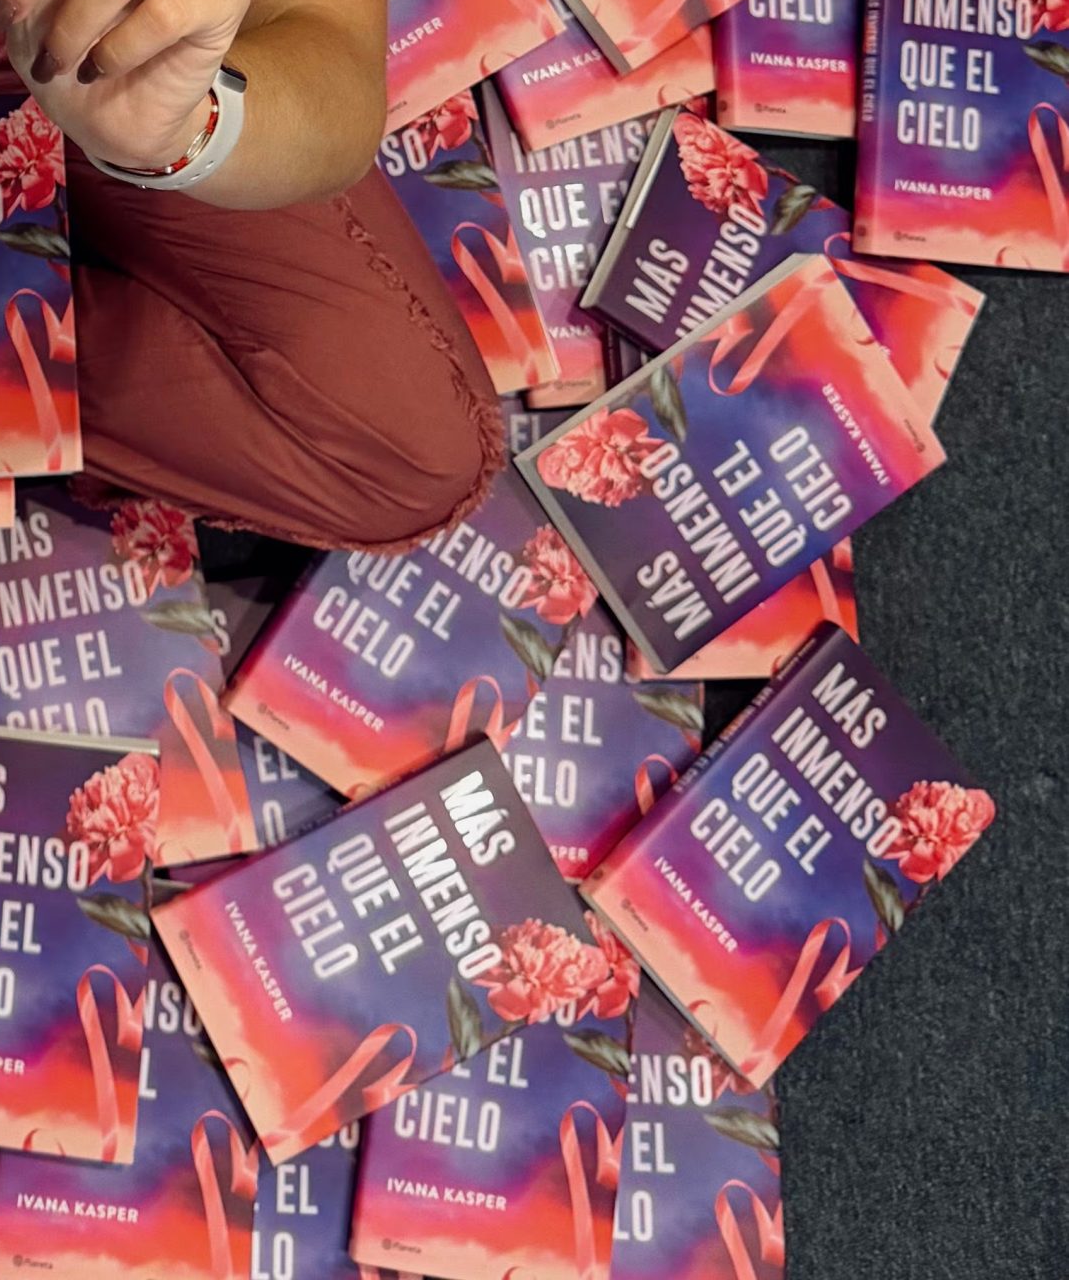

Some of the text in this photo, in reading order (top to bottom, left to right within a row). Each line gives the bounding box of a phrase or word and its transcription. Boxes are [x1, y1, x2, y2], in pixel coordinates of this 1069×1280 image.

[901, 40, 998, 94] QUE EL
[899, 99, 980, 153] CIELO
[896, 178, 990, 201] IVANA KASPER
[769, 425, 851, 530] CIELO
[819, 382, 892, 488] IVANA KASPER
[636, 442, 758, 601] INMENSO
[713, 439, 806, 565] QUE EL
[638, 551, 710, 638] MÁS
[813, 663, 886, 748] MÁS
[442, 775, 514, 865] MÁS
[732, 753, 832, 875] QUE EL
[772, 707, 904, 858] INMENSO
[386, 804, 505, 978] INMENSO
[691, 798, 781, 903] CIELO
[0, 900, 41, 953] EL
[273, 864, 359, 980] CIELO
[327, 834, 423, 973] QUE EL
[652, 855, 740, 954] IVANA KASPER
[223, 901, 294, 1023] IVANA KASPER
[396, 1086, 501, 1153] CIELO
[17, 1193, 139, 1224] IVANA KASPER
